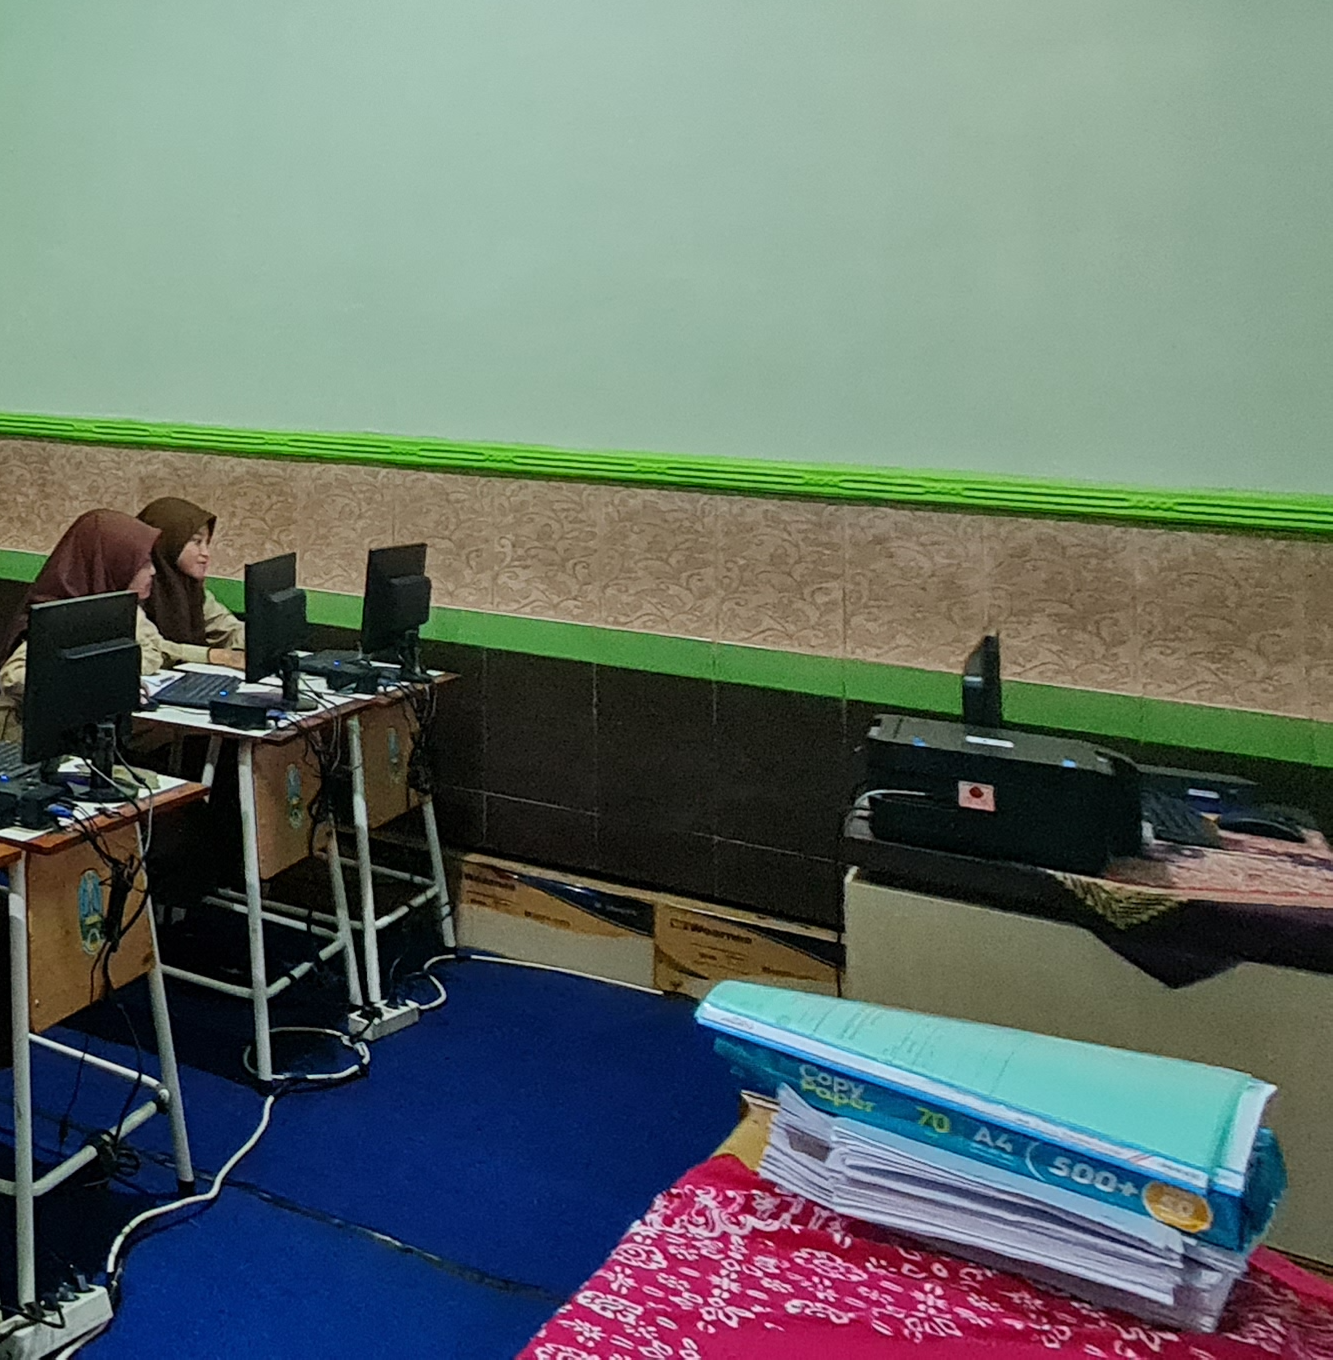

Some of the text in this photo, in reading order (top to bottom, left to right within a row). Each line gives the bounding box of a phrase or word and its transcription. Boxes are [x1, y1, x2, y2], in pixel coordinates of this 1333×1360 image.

[799, 1064, 865, 1099] Copy
[916, 1104, 952, 1134] 70
[973, 1126, 1013, 1153] A4
[1048, 1156, 1140, 1197] 500+
